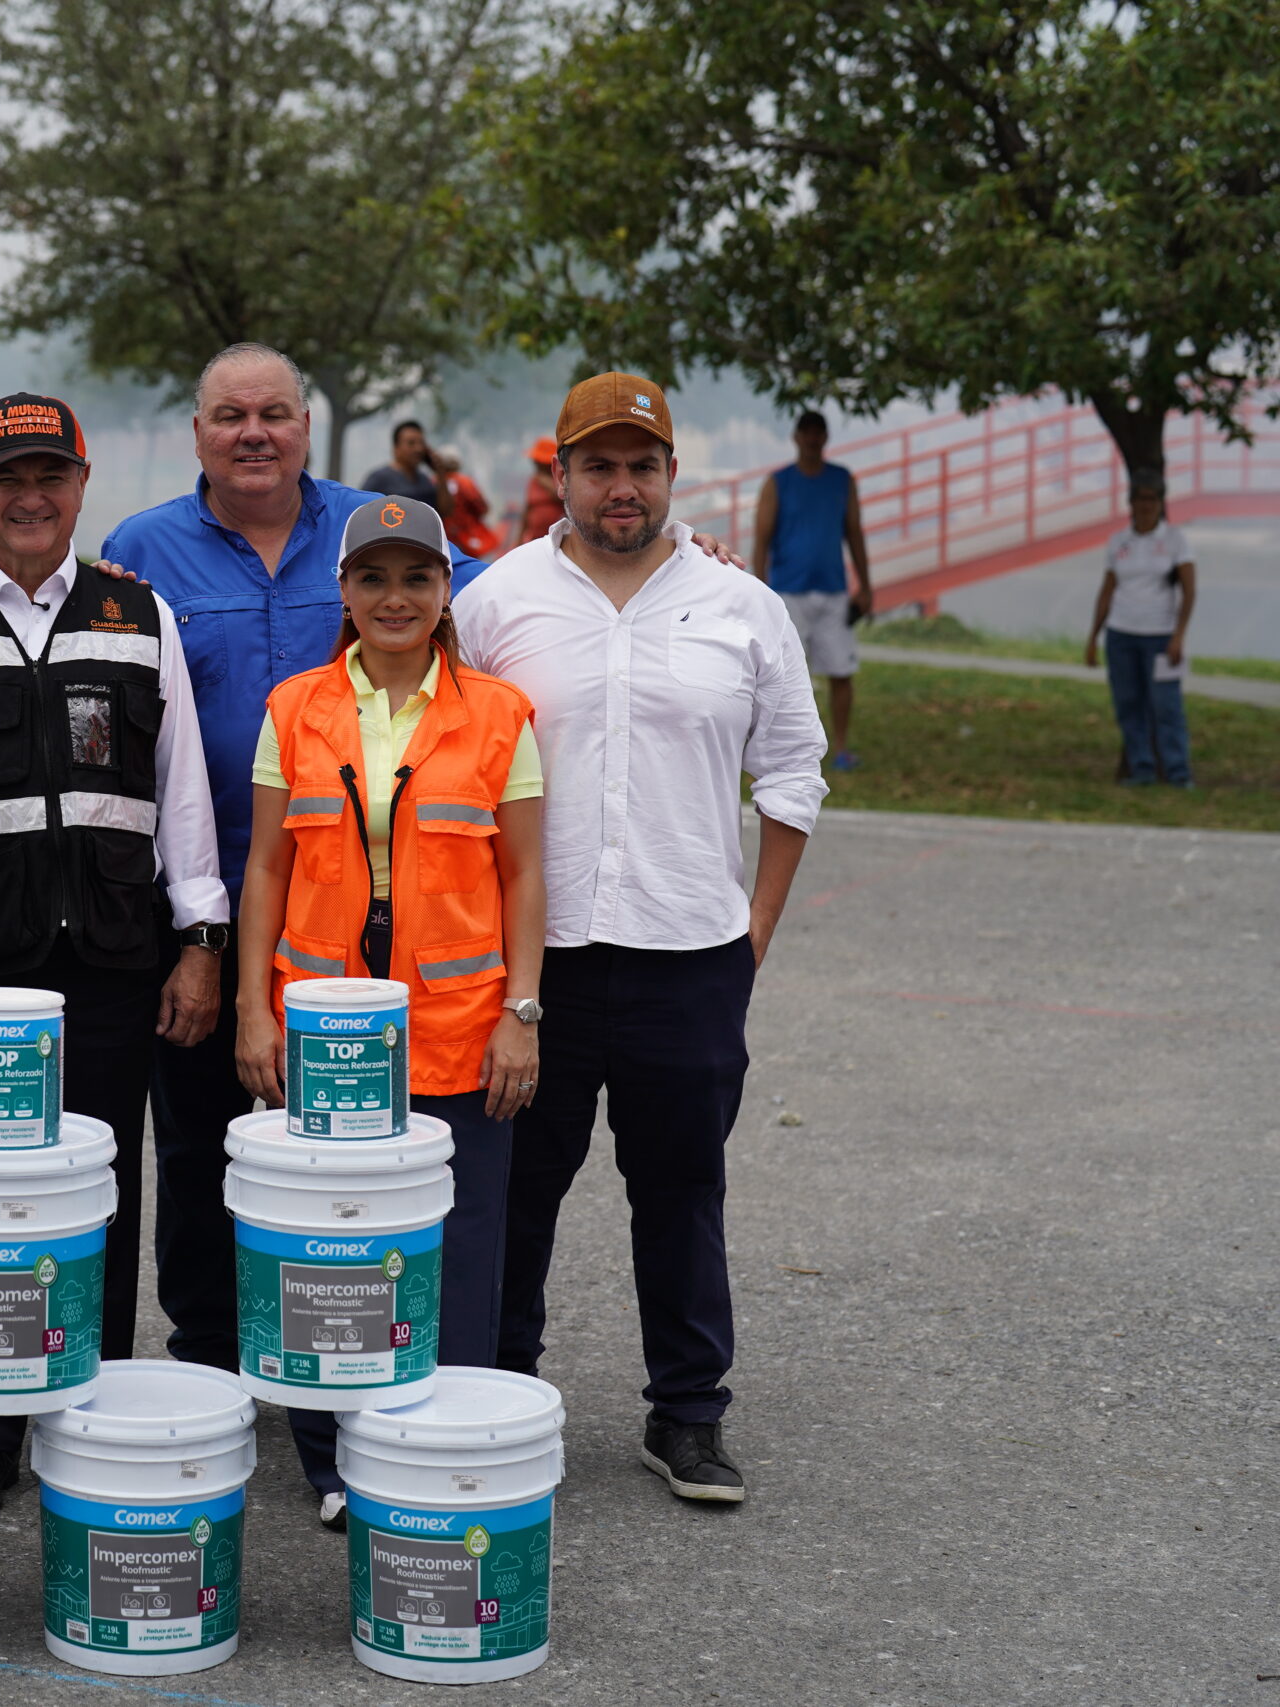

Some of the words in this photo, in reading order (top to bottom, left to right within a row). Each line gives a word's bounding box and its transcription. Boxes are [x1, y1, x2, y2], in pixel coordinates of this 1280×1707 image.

[7, 404, 60, 418] MUNDIAL
[631, 407, 656, 421] Comex
[7, 424, 62, 436] GUADALUPE
[91, 620, 138, 629] Guadalupe
[320, 1015, 375, 1030] Comex
[326, 1043, 364, 1060] TOP
[303, 1060, 349, 1070] Tapagoteras
[351, 1061, 389, 1069] Reforzado
[5, 1069, 43, 1078] Reforzado
[305, 1240, 374, 1257] Comex
[286, 1278, 388, 1298] Impercomex
[313, 1298, 363, 1306] Roofmastic
[47, 1331, 63, 1345] 10
[394, 1324, 409, 1339] 10
[299, 1360, 311, 1368] 19L
[293, 1368, 309, 1376] Mate
[114, 1508, 182, 1526] Comex
[389, 1511, 456, 1531] Comex
[196, 1531, 208, 1539] ECO
[94, 1547, 196, 1566] Impercomex
[374, 1546, 472, 1570] Impercomex
[122, 1566, 171, 1574] Roofmastic
[397, 1568, 445, 1581] Roofmastic
[202, 1589, 216, 1604] 10
[203, 1602, 215, 1610] años
[481, 1601, 497, 1616] 10
[107, 1627, 120, 1635] 19L
[386, 1627, 397, 1637] 19L
[381, 1635, 395, 1643] Mate
